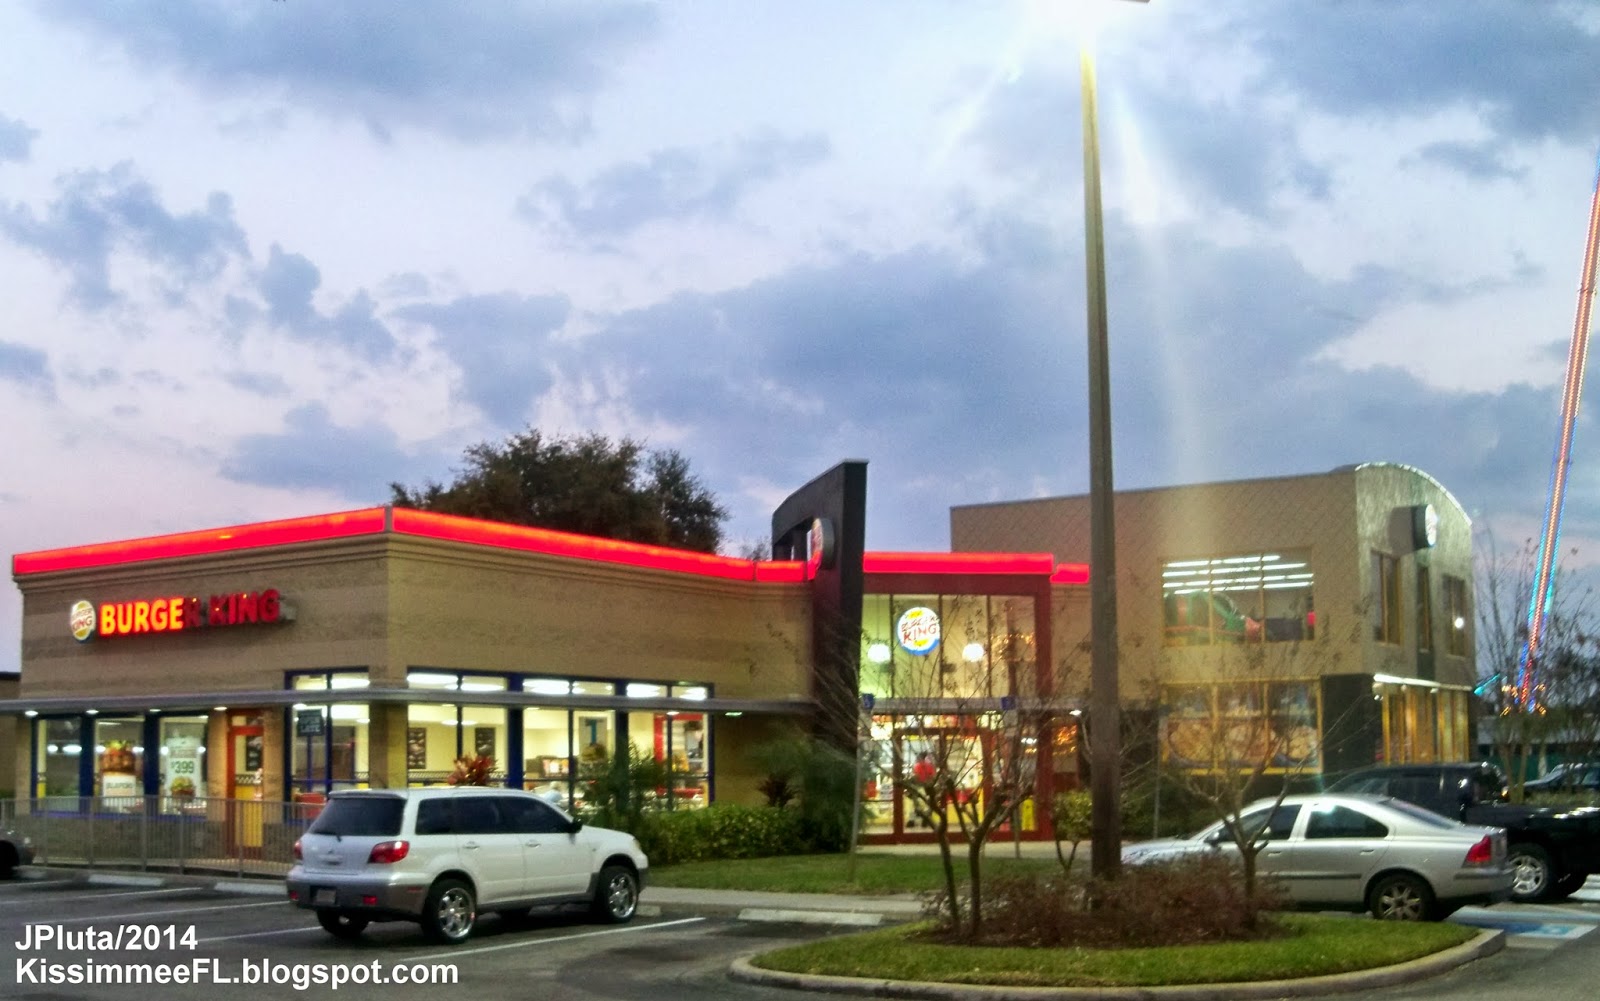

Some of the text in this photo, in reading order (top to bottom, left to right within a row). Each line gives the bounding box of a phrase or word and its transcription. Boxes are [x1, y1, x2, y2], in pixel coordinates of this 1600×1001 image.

[100, 589, 280, 636] BURGER KING
[903, 623, 936, 644] KING
